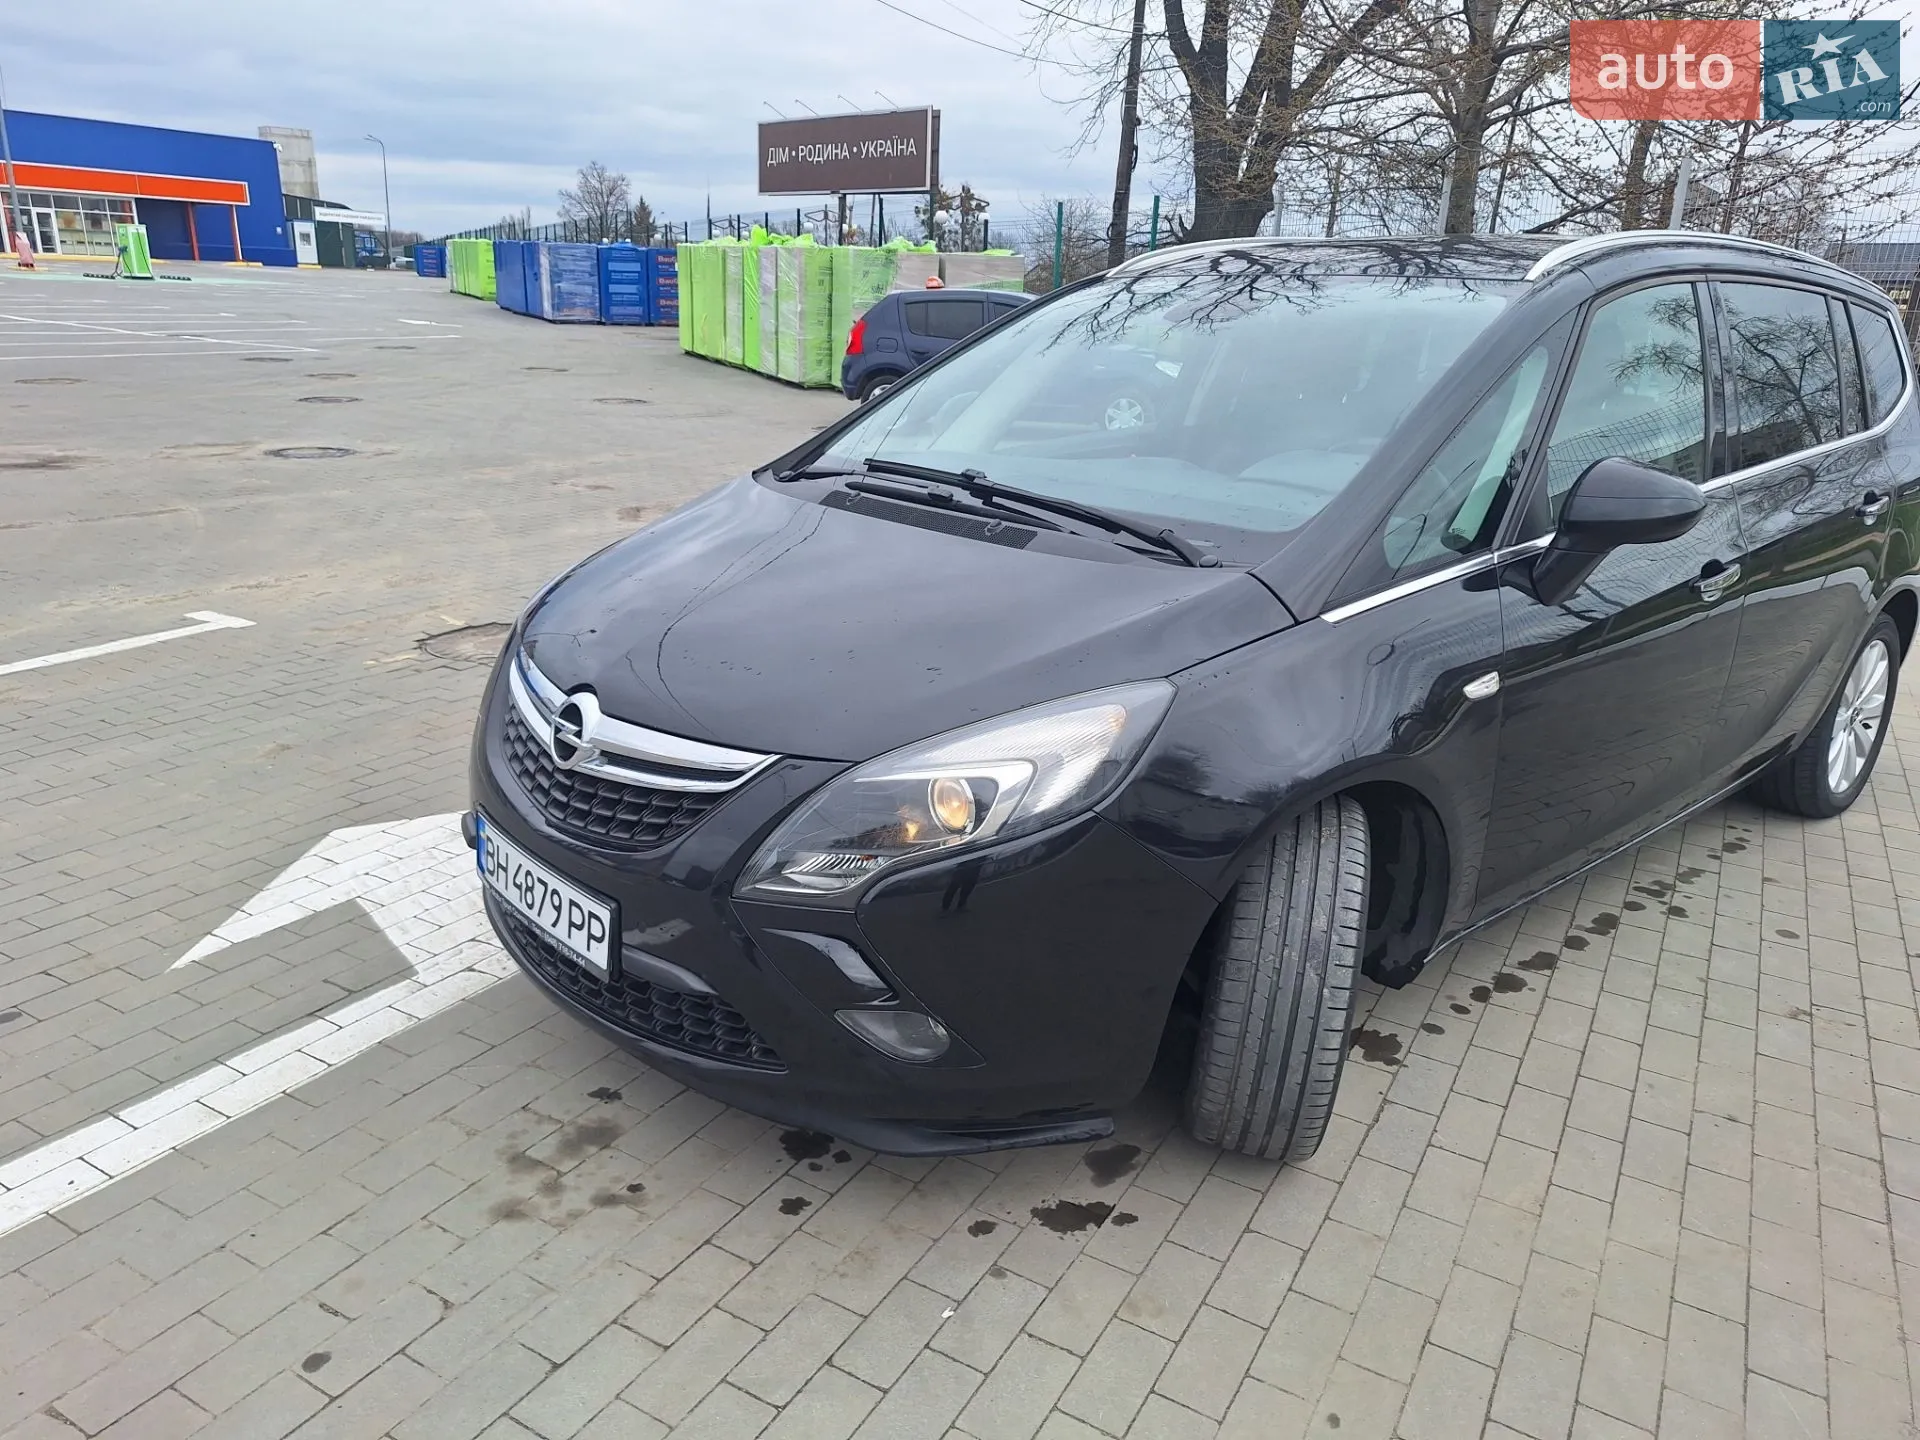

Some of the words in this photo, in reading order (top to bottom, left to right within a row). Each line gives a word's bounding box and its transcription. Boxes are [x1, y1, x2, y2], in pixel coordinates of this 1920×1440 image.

[767, 147, 789, 167] ДІМ
[798, 142, 850, 164] РОДИНА
[859, 135, 917, 158] УКРАЇНА
[486, 836, 509, 891] BH
[512, 863, 563, 929] 4879
[567, 898, 606, 952] PP
